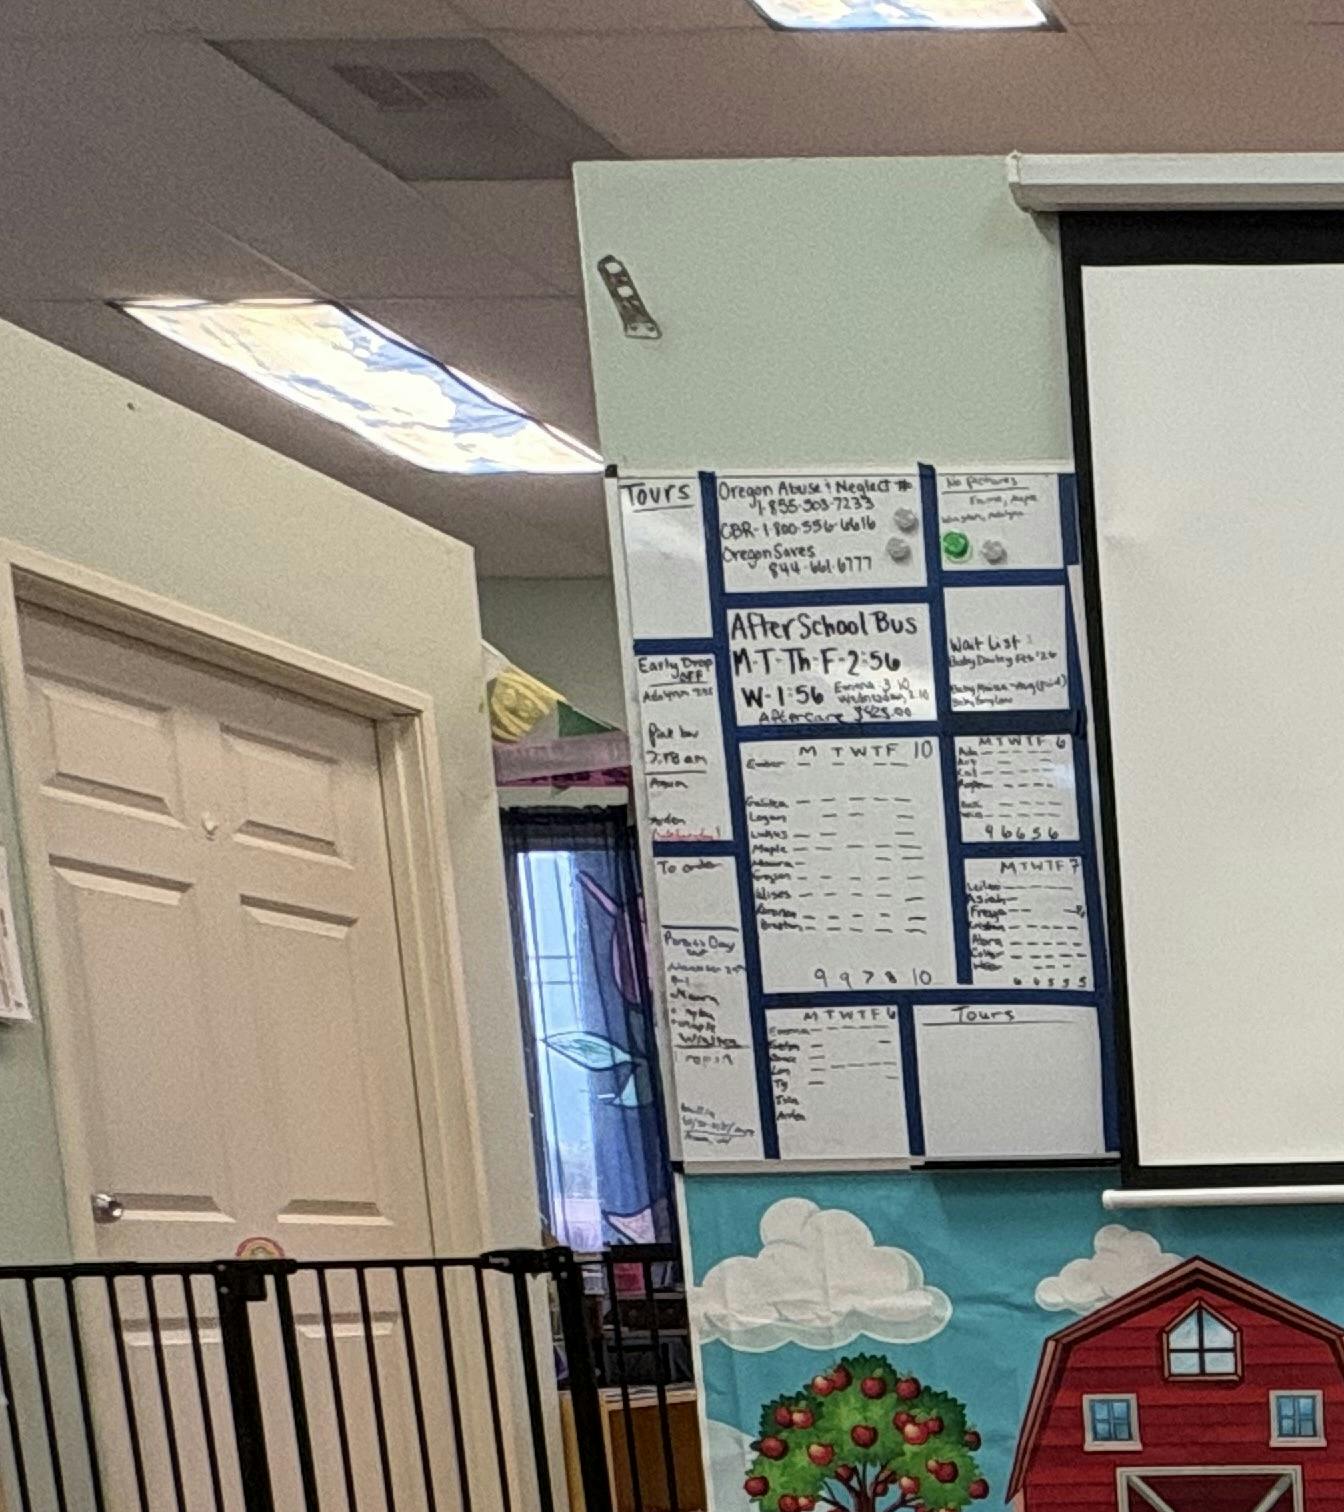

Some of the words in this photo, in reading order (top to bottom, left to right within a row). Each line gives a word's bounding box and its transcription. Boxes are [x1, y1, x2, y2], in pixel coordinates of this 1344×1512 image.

[620, 482, 690, 507] Tours
[719, 481, 773, 508] Oregon
[779, 482, 821, 496] Abuse
[836, 480, 891, 497] Neglect
[722, 546, 773, 570] Oregon
[731, 611, 796, 641] After
[798, 611, 868, 640] School
[870, 610, 918, 635] Bus
[638, 657, 679, 679] Early
[951, 1004, 1015, 1024] Tours
